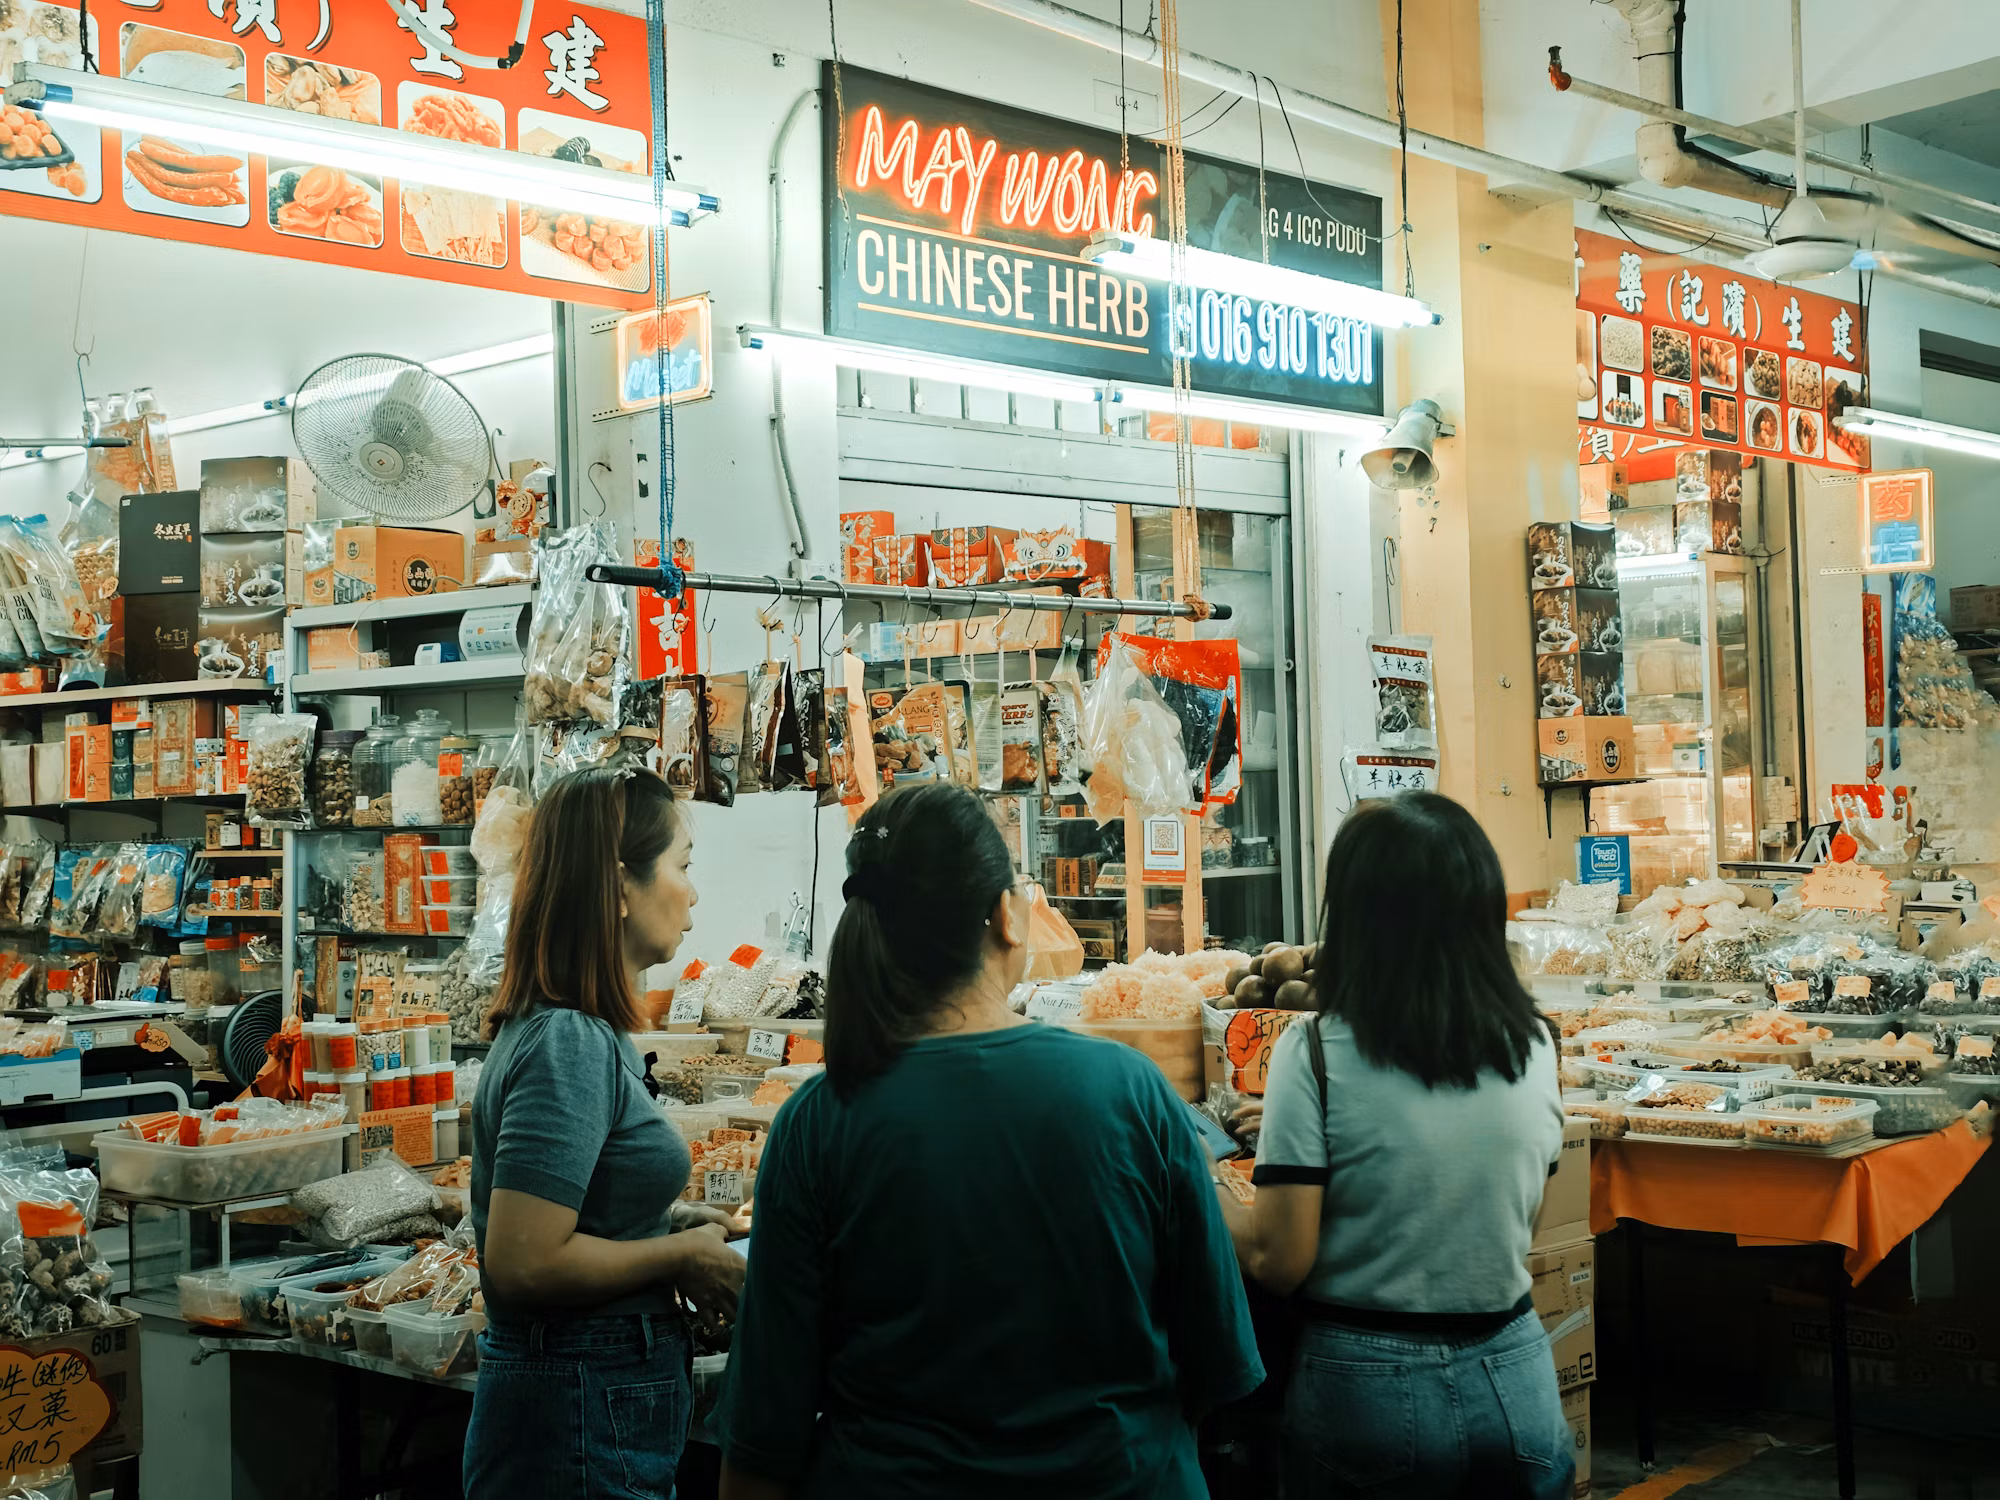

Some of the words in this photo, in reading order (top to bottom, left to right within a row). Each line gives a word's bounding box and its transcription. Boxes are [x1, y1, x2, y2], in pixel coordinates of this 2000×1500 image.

[856, 105, 996, 234] MAY
[1000, 150, 1158, 239] WONG
[1283, 212, 1293, 240] 4
[1297, 214, 1322, 246] ICC
[1326, 221, 1366, 256] PUDU
[857, 229, 1034, 322] CHINESE
[1049, 264, 1150, 340] HERB
[1200, 288, 1252, 366] 016
[1258, 300, 1307, 375] 910
[1311, 309, 1374, 385] 1301
[1866, 604, 1881, 714] 大吉大利
[1367, 768, 1426, 790] 羊肚菌
[1041, 996, 1056, 1007] Nut
